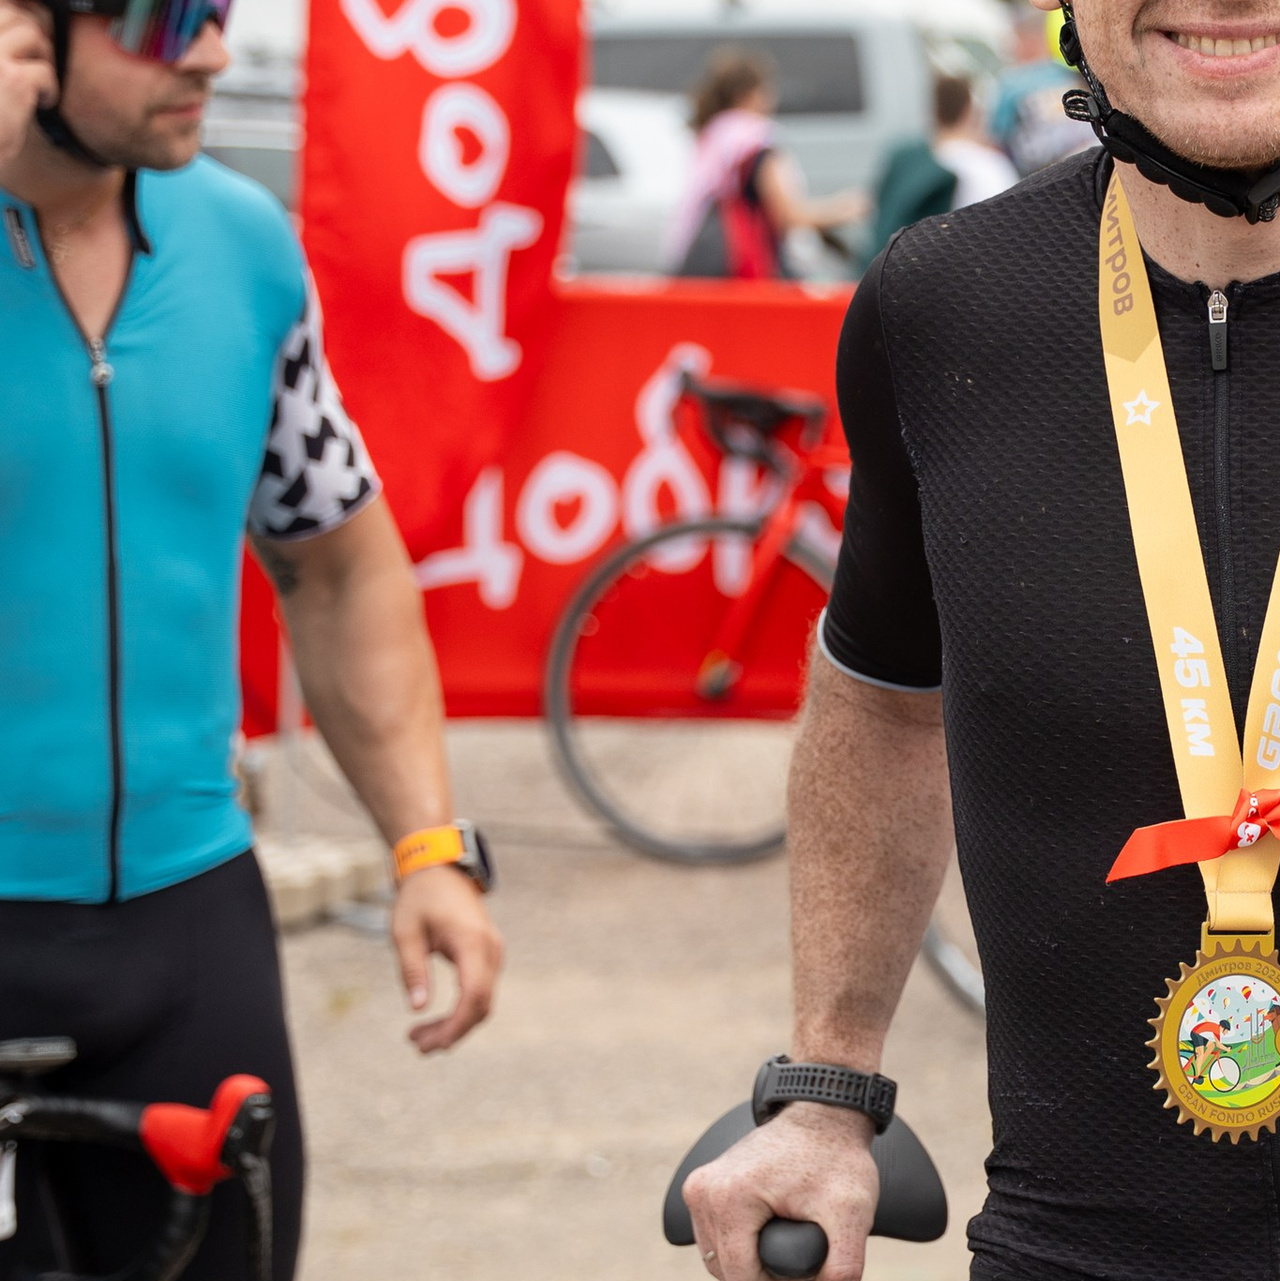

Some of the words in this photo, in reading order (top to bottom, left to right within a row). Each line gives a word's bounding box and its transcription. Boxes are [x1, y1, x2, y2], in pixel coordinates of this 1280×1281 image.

[1170, 626, 1211, 688] 45
[1178, 1084, 1207, 1115] GRAN
[1209, 1109, 1255, 1124] FONDO
